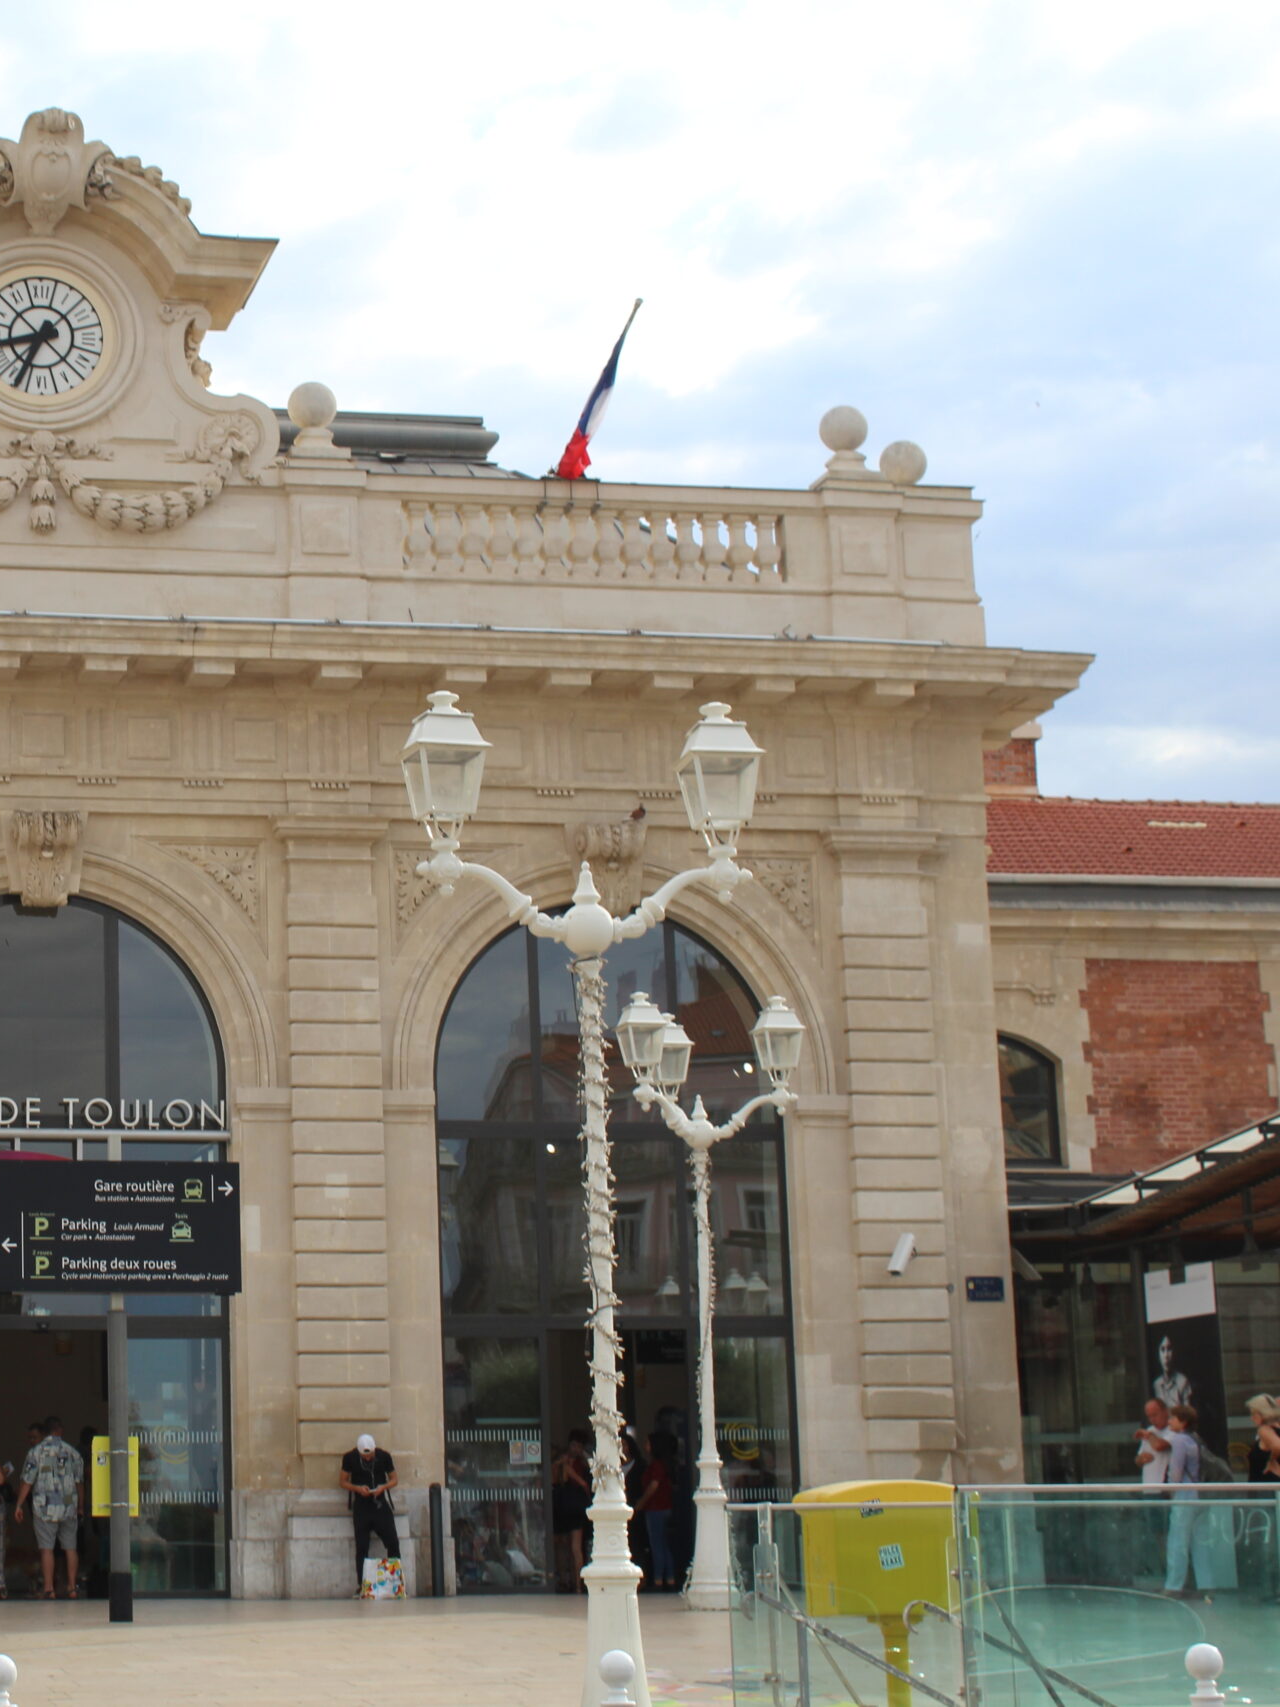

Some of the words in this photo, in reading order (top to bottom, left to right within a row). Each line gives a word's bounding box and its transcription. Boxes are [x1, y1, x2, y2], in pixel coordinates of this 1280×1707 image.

[33, 285, 49, 299] XII
[81, 332, 95, 347] III
[36, 375, 47, 389] VI
[63, 1098, 225, 1128] TOULON
[94, 1179, 122, 1192] Gare
[126, 1179, 174, 1193] routière
[95, 1194, 106, 1202] Bus
[107, 1194, 129, 1202] station
[61, 1218, 106, 1233] Parking
[114, 1222, 133, 1231] Louis
[135, 1222, 164, 1231] Armand
[61, 1233, 72, 1241] Car
[73, 1233, 87, 1242] park
[61, 1256, 107, 1272] Parking
[110, 1257, 140, 1269] deux
[143, 1260, 177, 1270] roues
[61, 1272, 78, 1281] Cycle
[80, 1272, 92, 1280] and
[93, 1272, 127, 1281] motorcycle
[128, 1272, 151, 1282] parking
